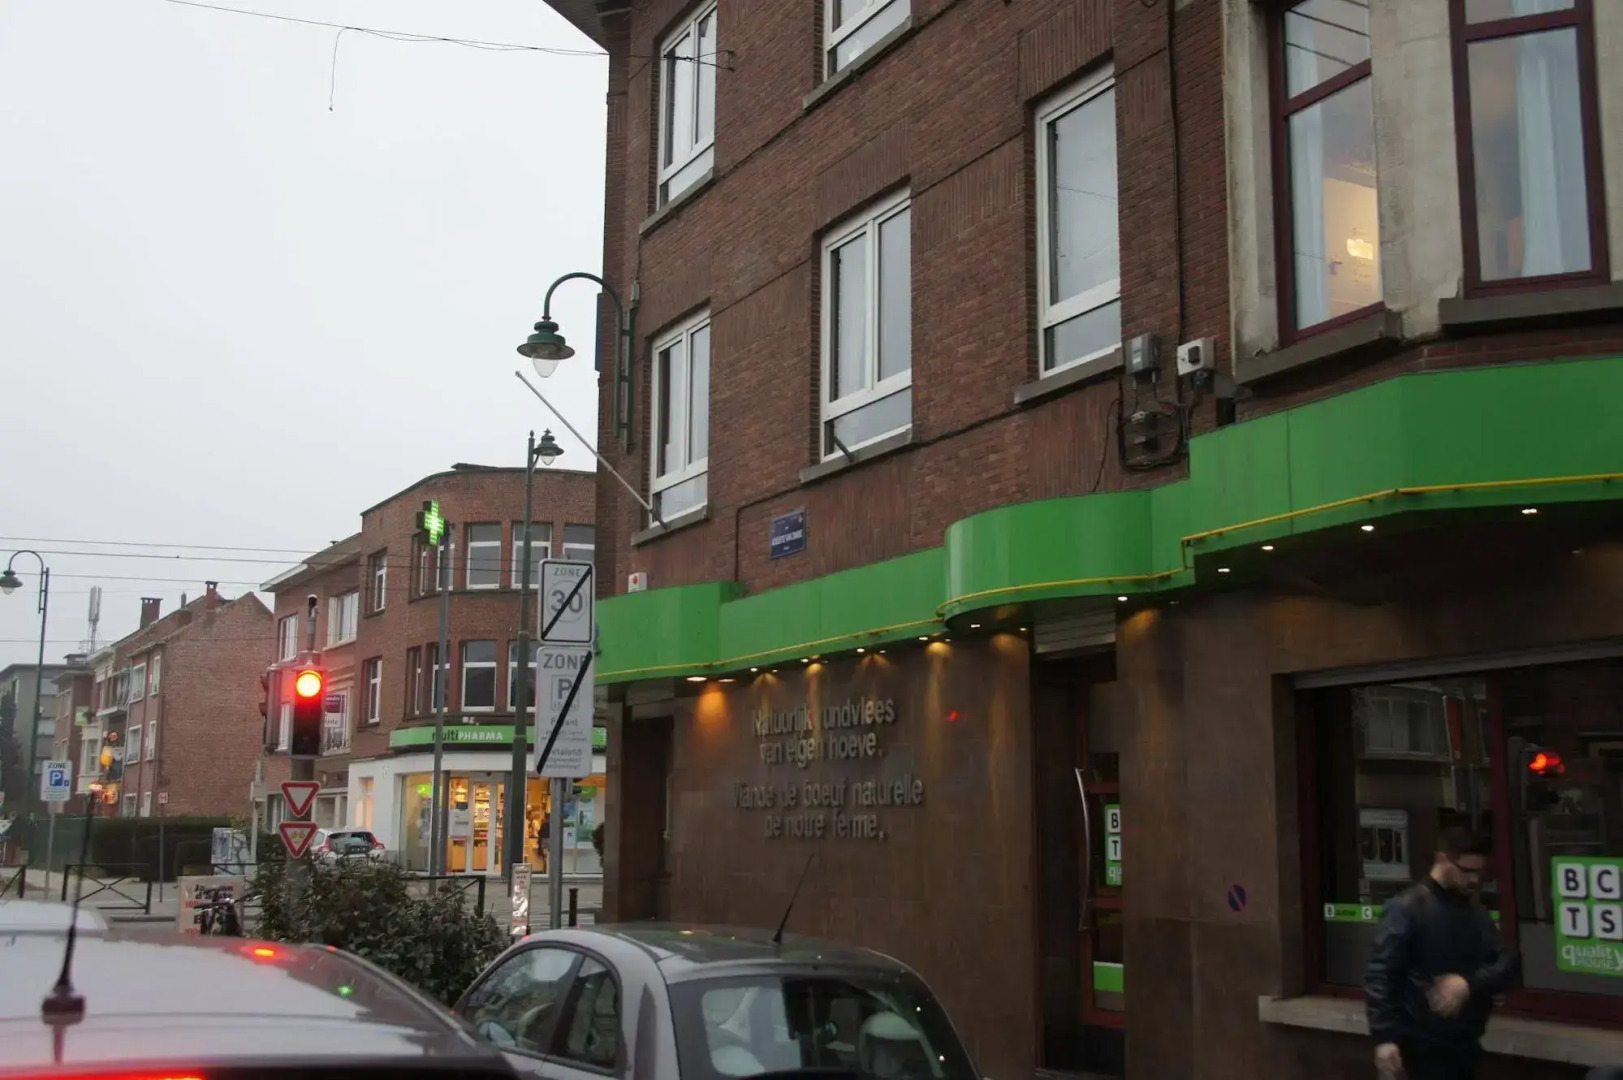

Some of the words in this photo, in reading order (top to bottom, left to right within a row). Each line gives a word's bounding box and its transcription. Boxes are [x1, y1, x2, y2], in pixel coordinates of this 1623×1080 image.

[554, 567, 582, 577] ZONE
[551, 589, 583, 613] 30
[759, 741, 783, 765] van
[52, 772, 62, 785] P
[852, 773, 925, 806] naturelle
